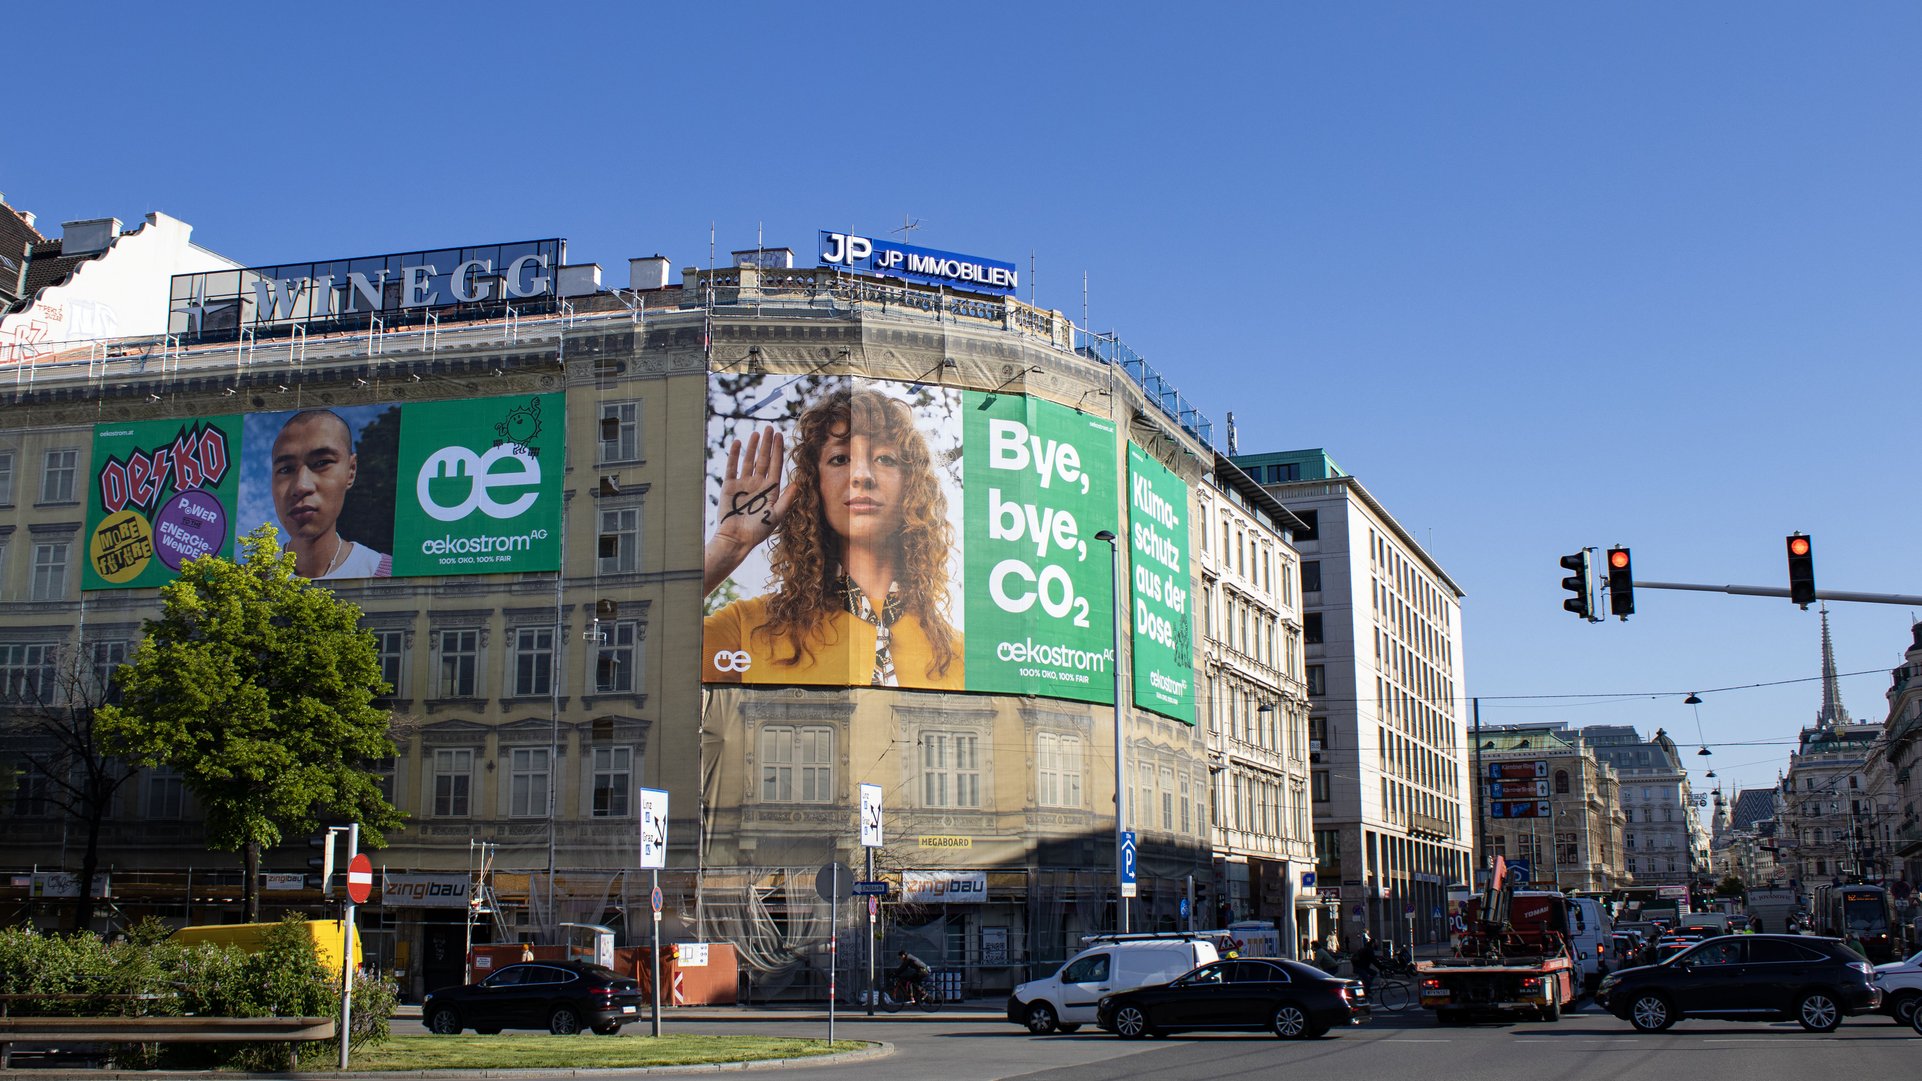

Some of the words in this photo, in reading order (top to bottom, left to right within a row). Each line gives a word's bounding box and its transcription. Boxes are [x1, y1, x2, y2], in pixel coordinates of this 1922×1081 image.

[823, 233, 872, 265] JP
[252, 254, 551, 321] WINEGG
[878, 250, 904, 268] JP
[908, 253, 1018, 288] IMMOBILIEN
[989, 418, 1090, 495] Bye,
[1133, 471, 1179, 530] Klima-
[988, 487, 1087, 562] bye,
[439, 557, 456, 565] 100%
[1134, 522, 1180, 574] schutz
[1136, 564, 1162, 602] aus
[1164, 575, 1186, 615] der
[1137, 597, 1176, 650] Dose.
[1019, 668, 1040, 678] 100%
[1058, 672, 1074, 682] 100%
[1075, 674, 1089, 683] FAIR
[921, 838, 969, 847] MEGABOARD
[1126, 849, 1133, 874] P
[386, 881, 465, 899] zinglbau
[907, 879, 984, 896] zinglbau
